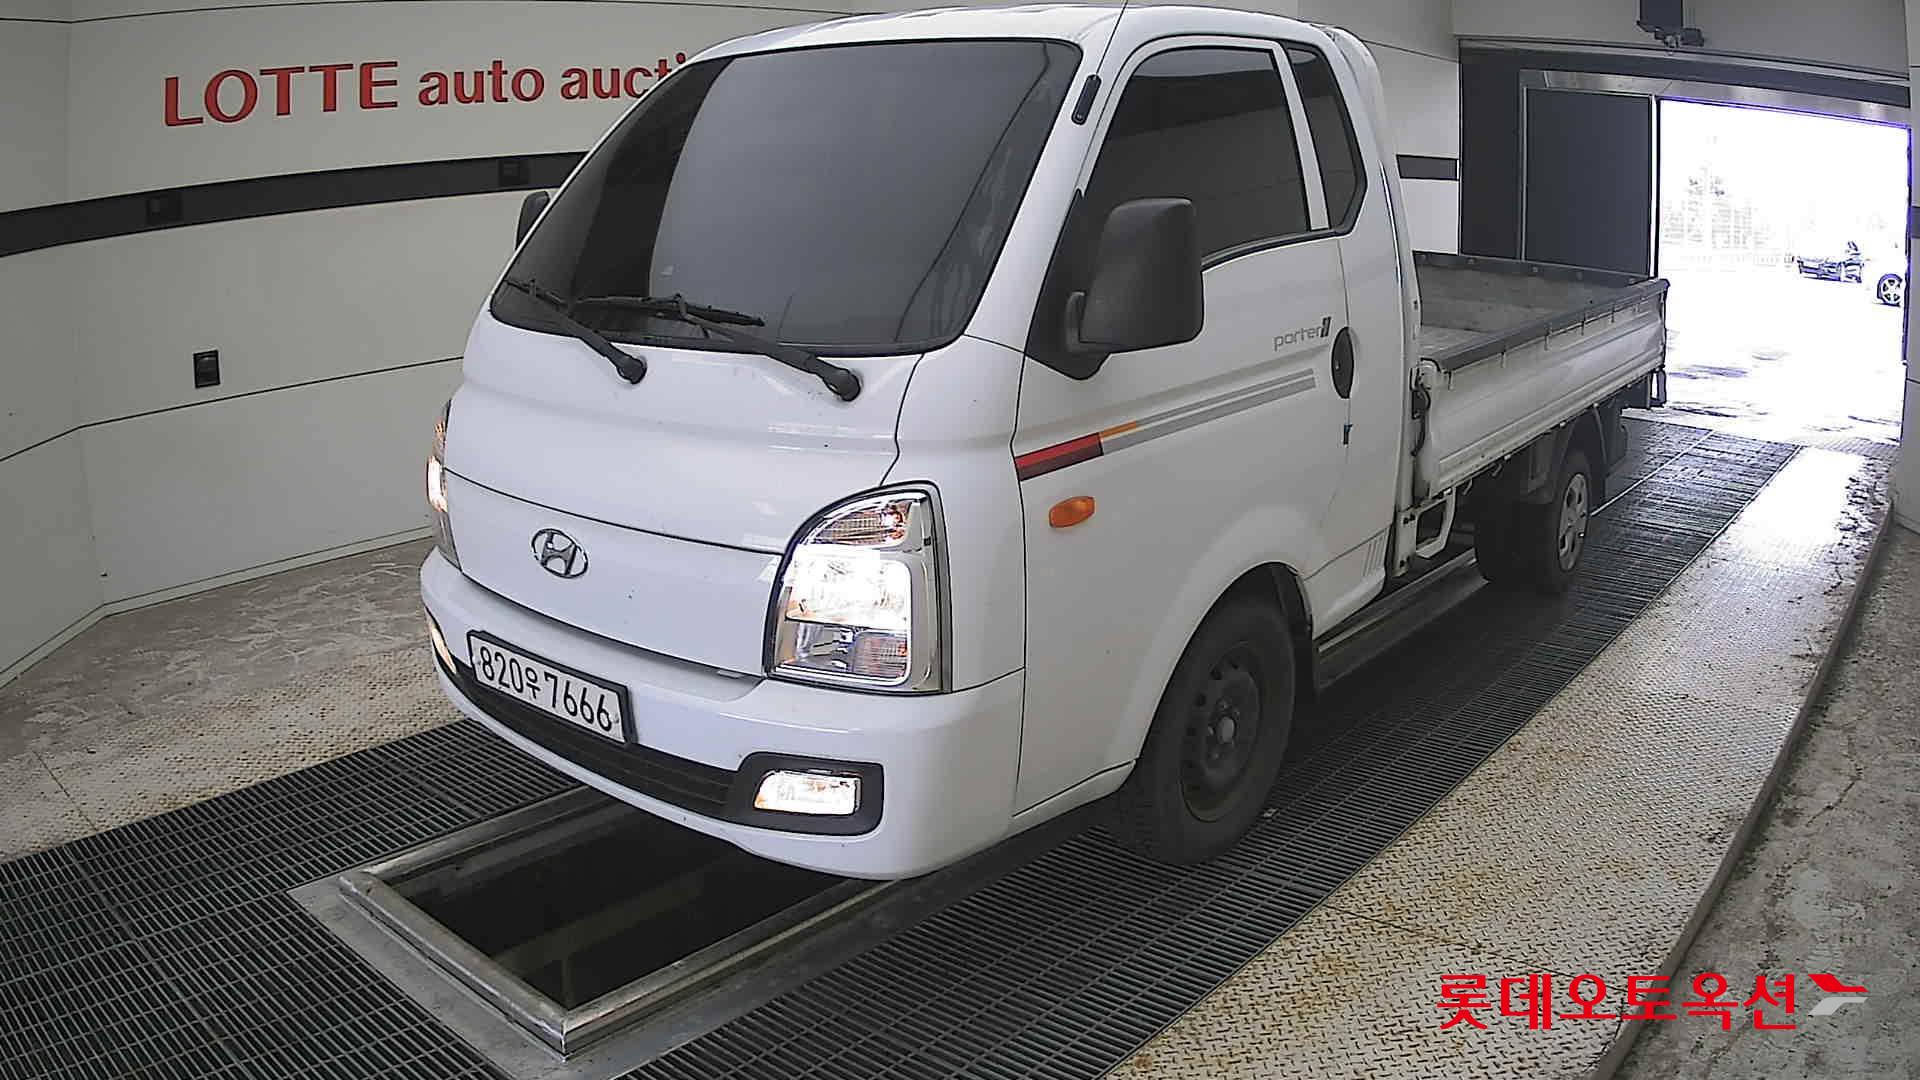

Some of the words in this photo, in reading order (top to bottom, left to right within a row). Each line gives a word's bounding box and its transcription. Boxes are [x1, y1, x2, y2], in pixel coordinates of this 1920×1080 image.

[164, 60, 399, 127] LOTTE
[418, 59, 546, 106] auto
[1273, 326, 1321, 352] porter
[479, 646, 613, 732] 820우7666
